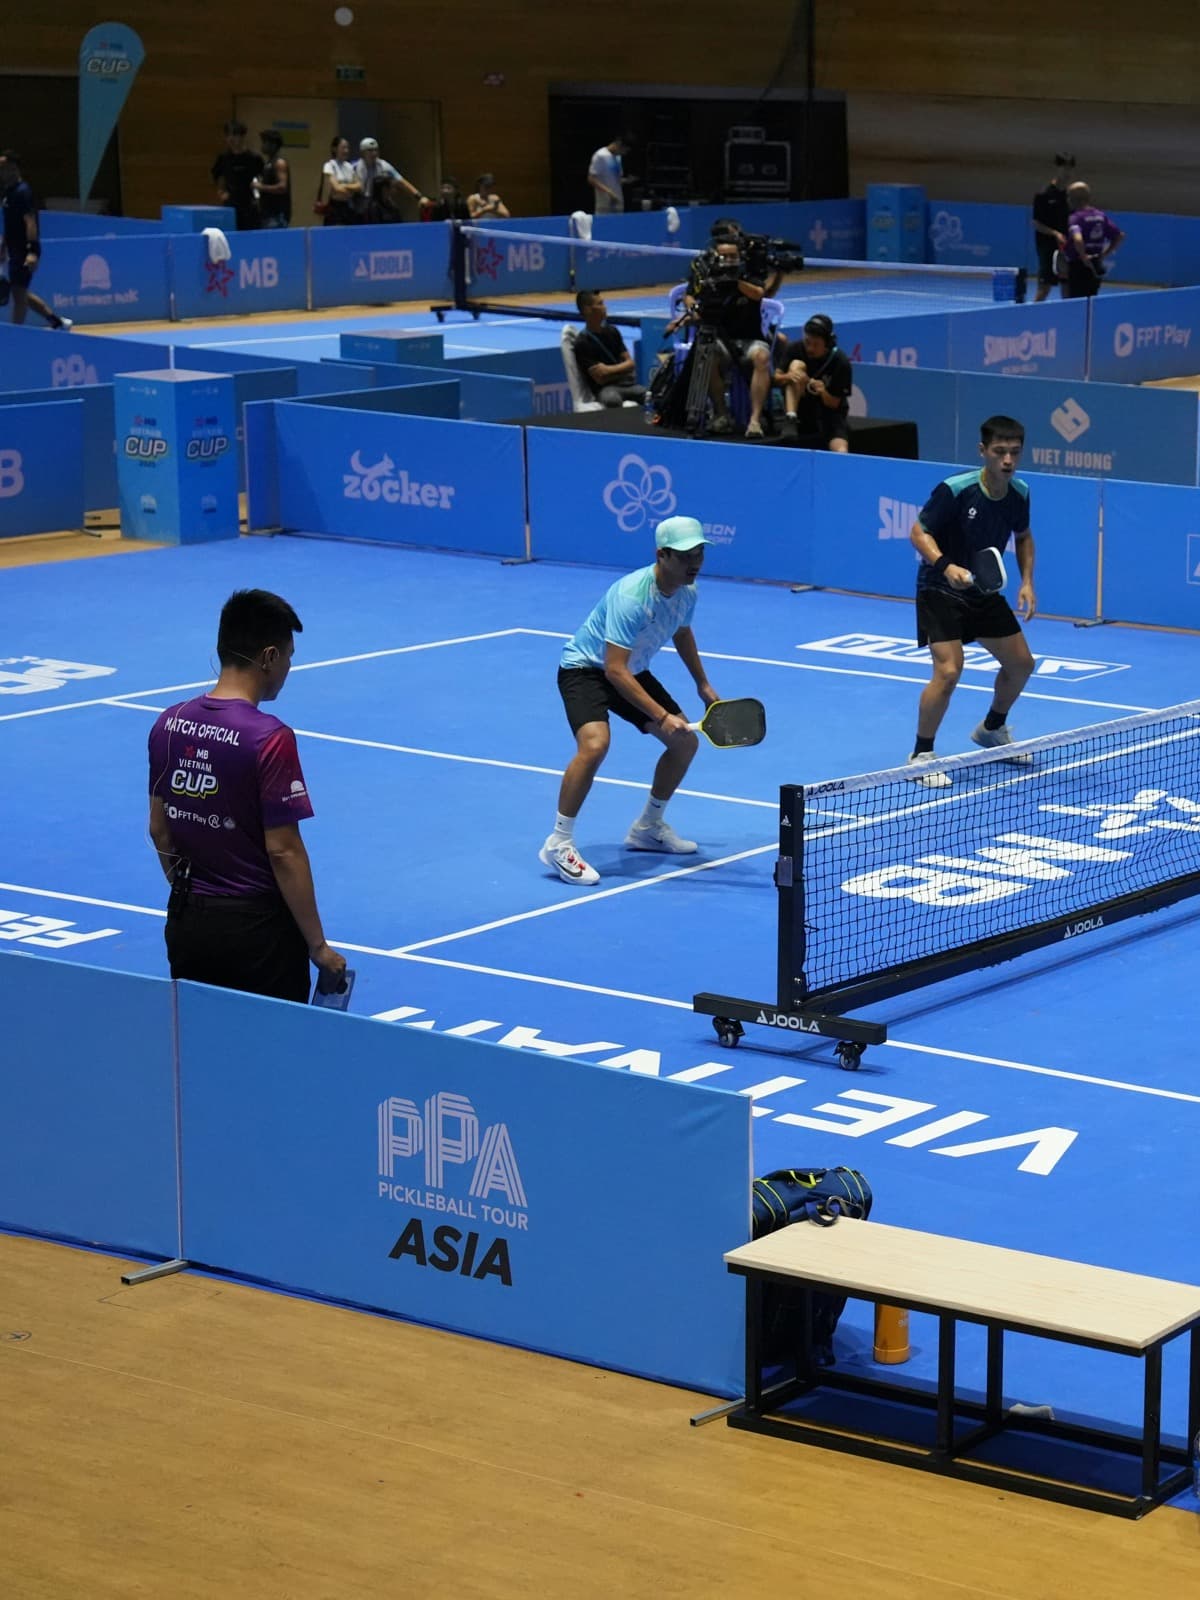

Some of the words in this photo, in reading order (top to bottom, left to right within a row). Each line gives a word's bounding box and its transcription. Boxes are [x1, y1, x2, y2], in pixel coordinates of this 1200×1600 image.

[507, 242, 545, 272] MB
[239, 256, 280, 289] MB
[1136, 324, 1162, 348] FPT
[1164, 323, 1192, 348] Play
[125, 436, 167, 458] CUP
[186, 436, 228, 459] CUP
[1032, 447, 1061, 465] VIET
[1064, 449, 1113, 471] HUONG
[343, 469, 456, 510] zocker
[164, 717, 198, 737] MATCH
[197, 724, 241, 747] OFFICIAL
[178, 758, 212, 772] VIETNAM
[196, 748, 209, 760] MB
[171, 769, 217, 796] CUP
[814, 781, 845, 795] JOOLA
[177, 809, 193, 821] FPT
[841, 832, 1134, 906] MB
[1071, 915, 1104, 937] JOOLA
[768, 1013, 821, 1034] JOOLA
[378, 1091, 529, 1209] PPA
[378, 1181, 477, 1219] PICKLEBALL
[481, 1204, 529, 1231] TOUR
[388, 1217, 513, 1287] ASIA
